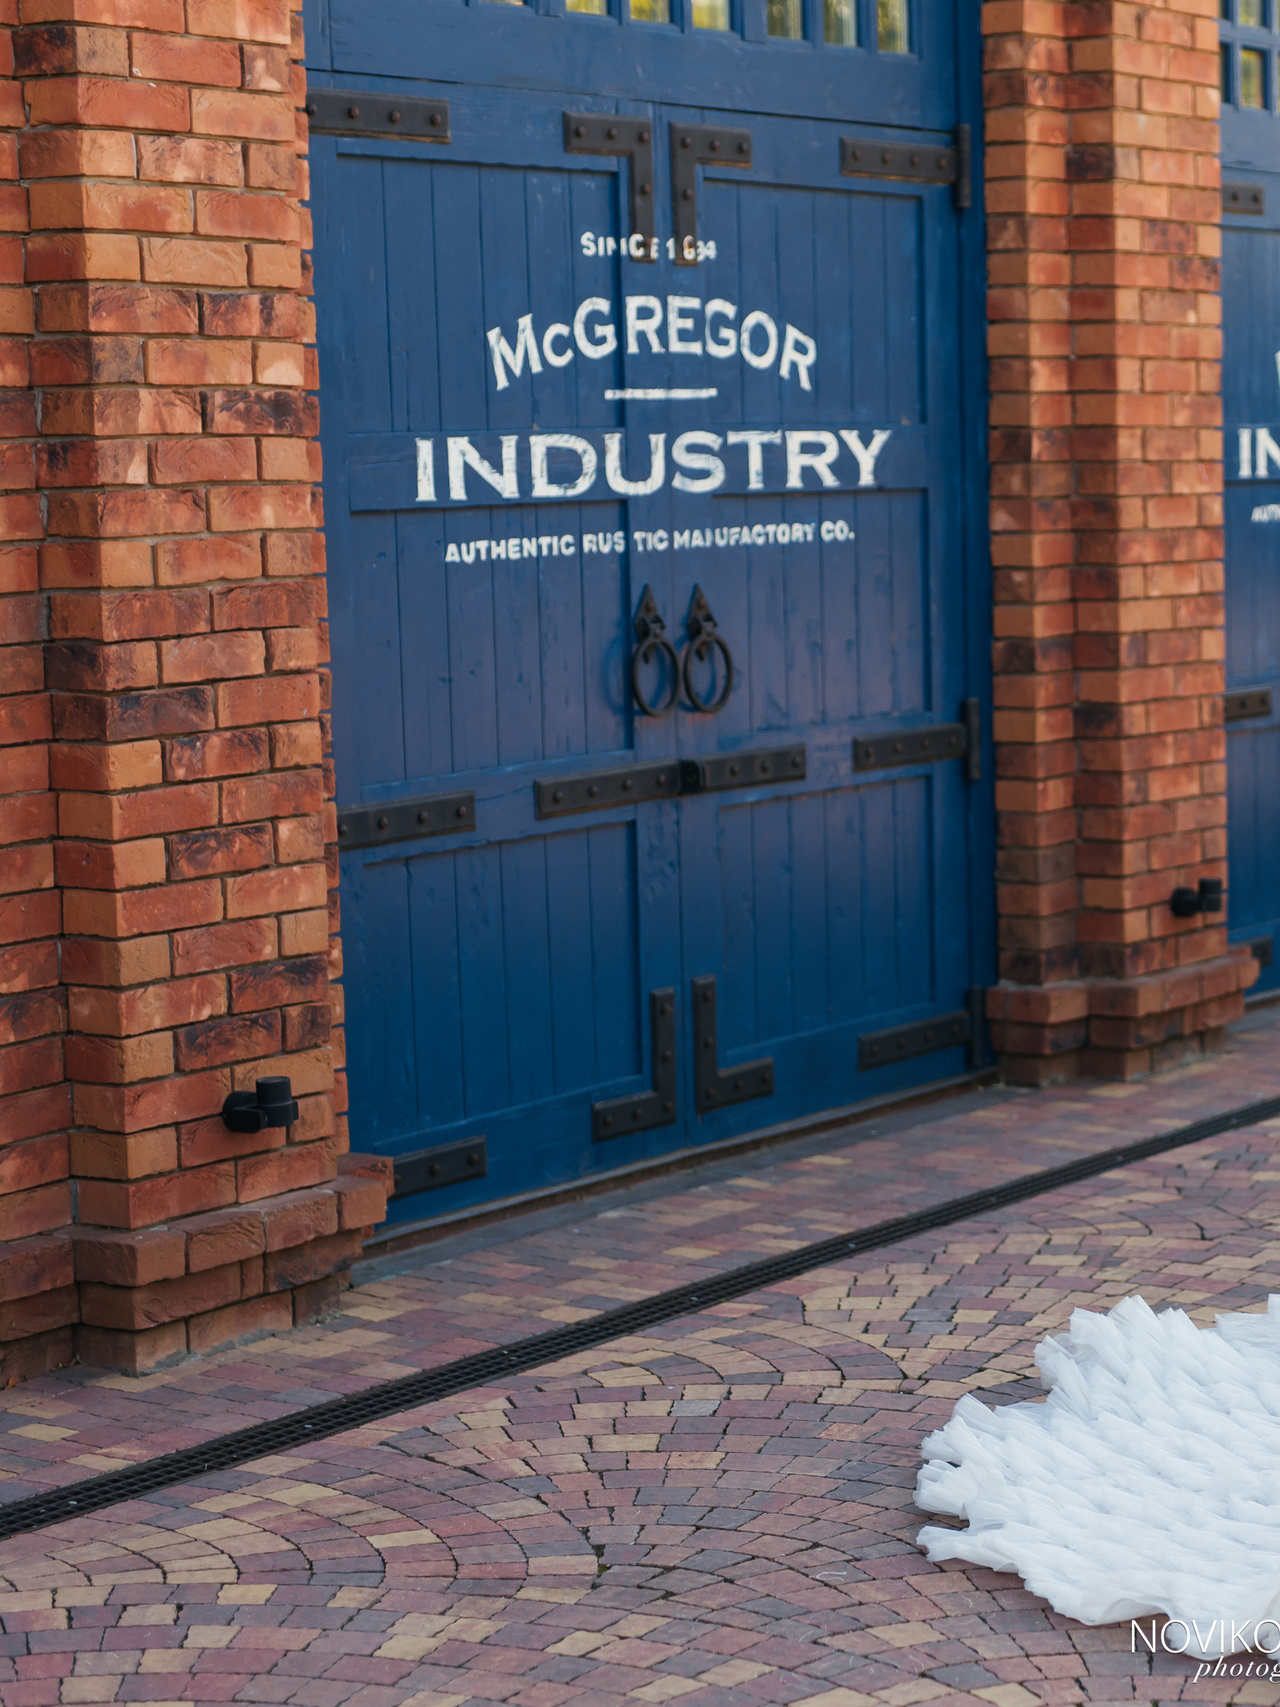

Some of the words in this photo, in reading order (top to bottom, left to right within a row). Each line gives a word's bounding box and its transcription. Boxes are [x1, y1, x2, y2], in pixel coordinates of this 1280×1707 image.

[580, 231, 660, 260] SINCE
[486, 295, 817, 392] McGREGOR
[415, 429, 893, 502] INDUSTRY
[445, 533, 576, 564] AUTHENTIC
[820, 519, 856, 543] CO.
